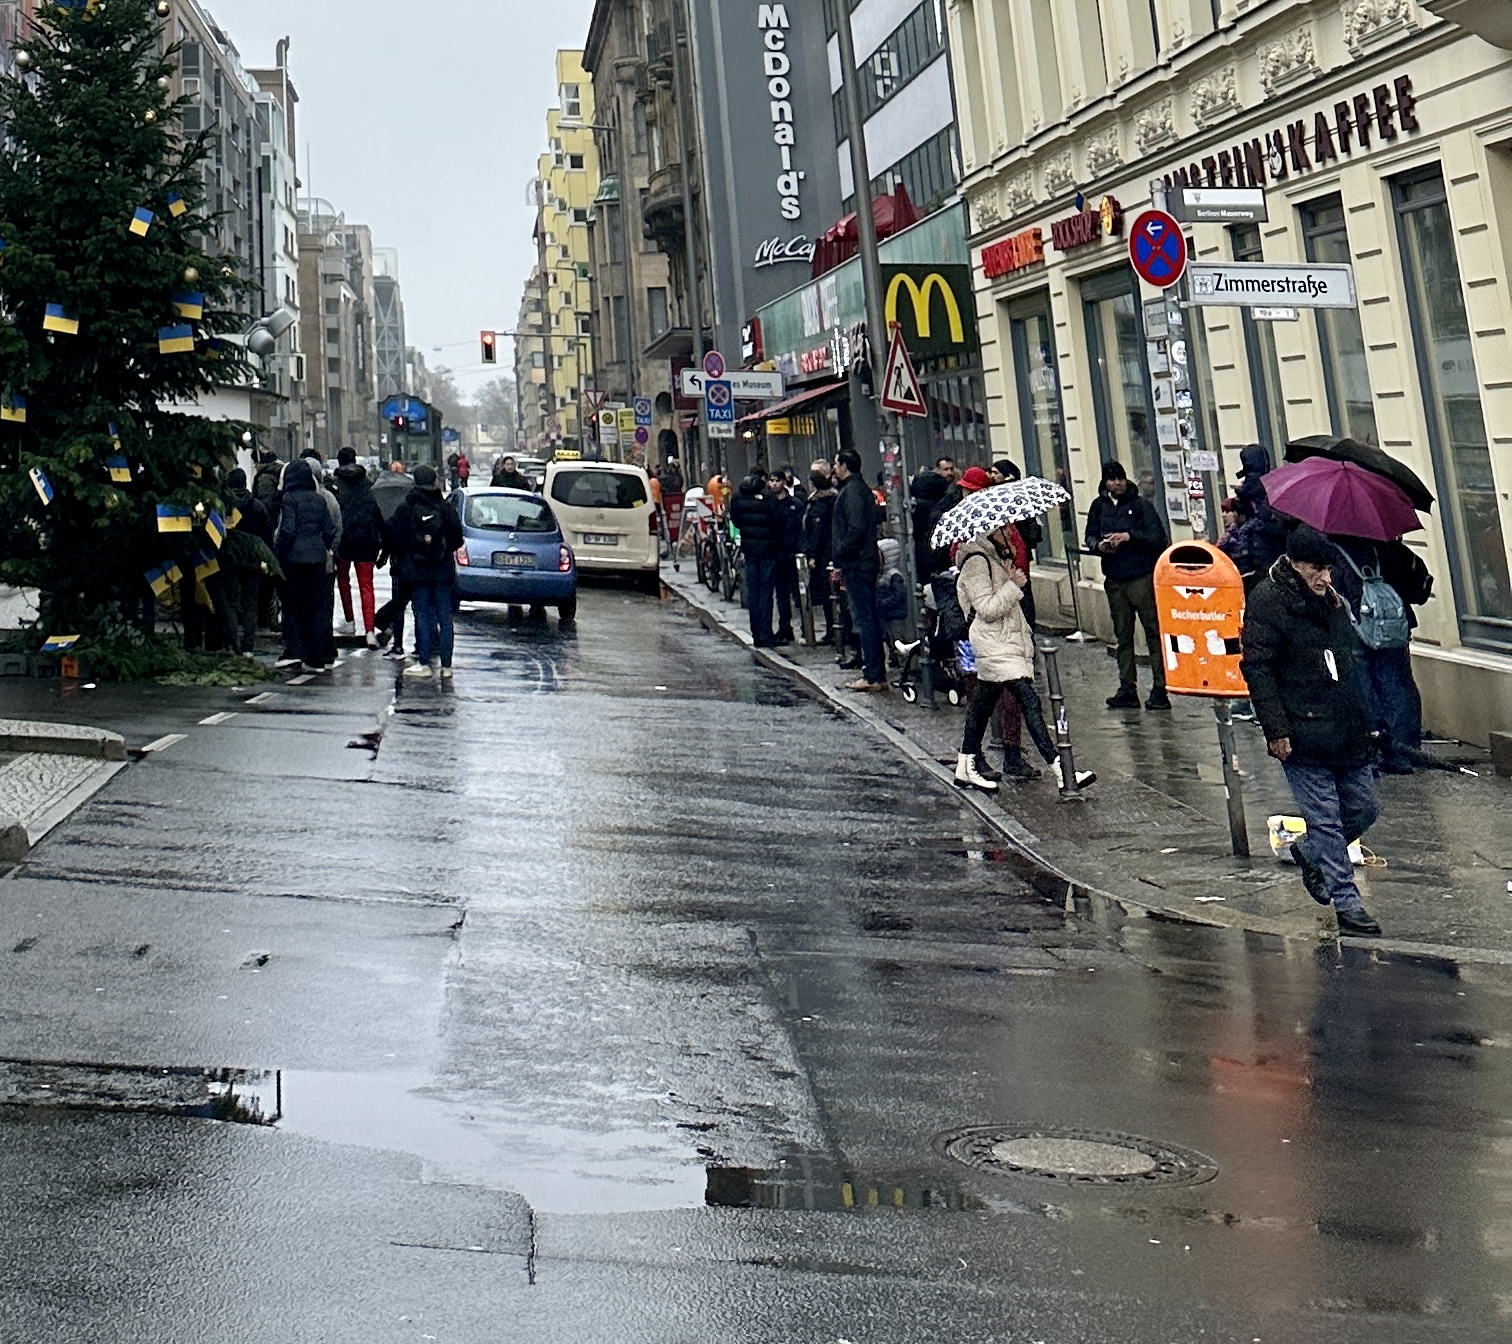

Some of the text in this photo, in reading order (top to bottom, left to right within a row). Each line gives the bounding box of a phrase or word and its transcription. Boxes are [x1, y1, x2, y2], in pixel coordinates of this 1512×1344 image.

[758, 4, 805, 220] McDonald's
[1288, 75, 1418, 171] KAFFEE
[1197, 209, 1254, 218] Berliner Mauerweg
[1213, 272, 1328, 298] Zimmerstraße
[742, 379, 772, 389] Museum
[709, 409, 731, 419] TAXI
[1171, 608, 1226, 621] Becherbutler
